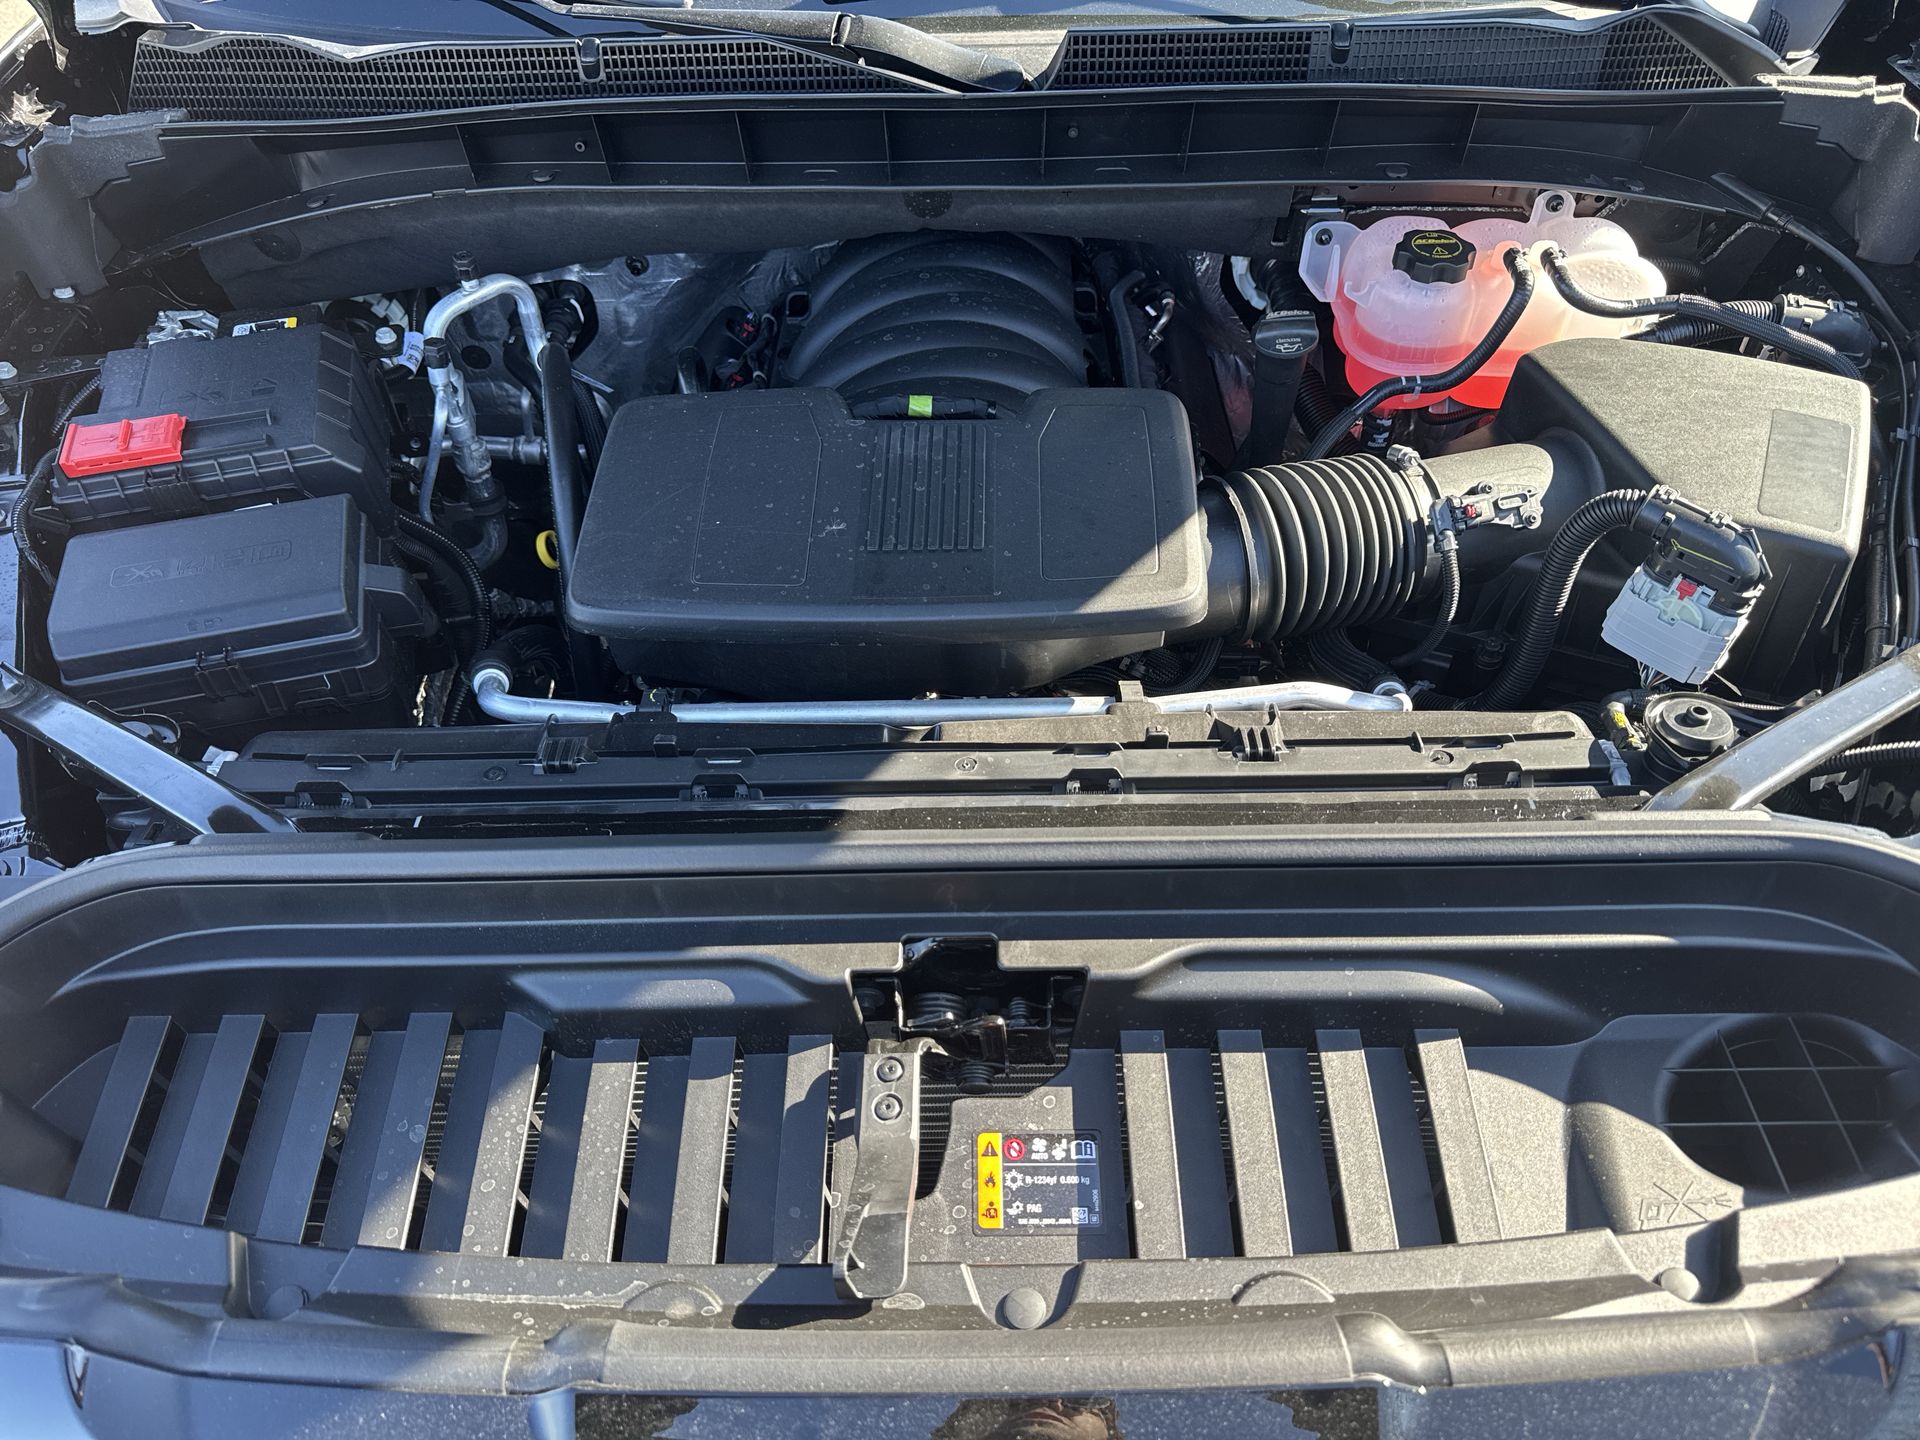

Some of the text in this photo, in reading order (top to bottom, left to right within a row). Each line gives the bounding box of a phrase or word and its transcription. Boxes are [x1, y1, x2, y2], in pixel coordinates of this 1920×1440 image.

[1266, 310, 1309, 319] ACDelco
[1025, 1176, 1057, 1185] R-1234yf
[1081, 1176, 1090, 1185] kg
[1026, 1204, 1042, 1213] PAG
